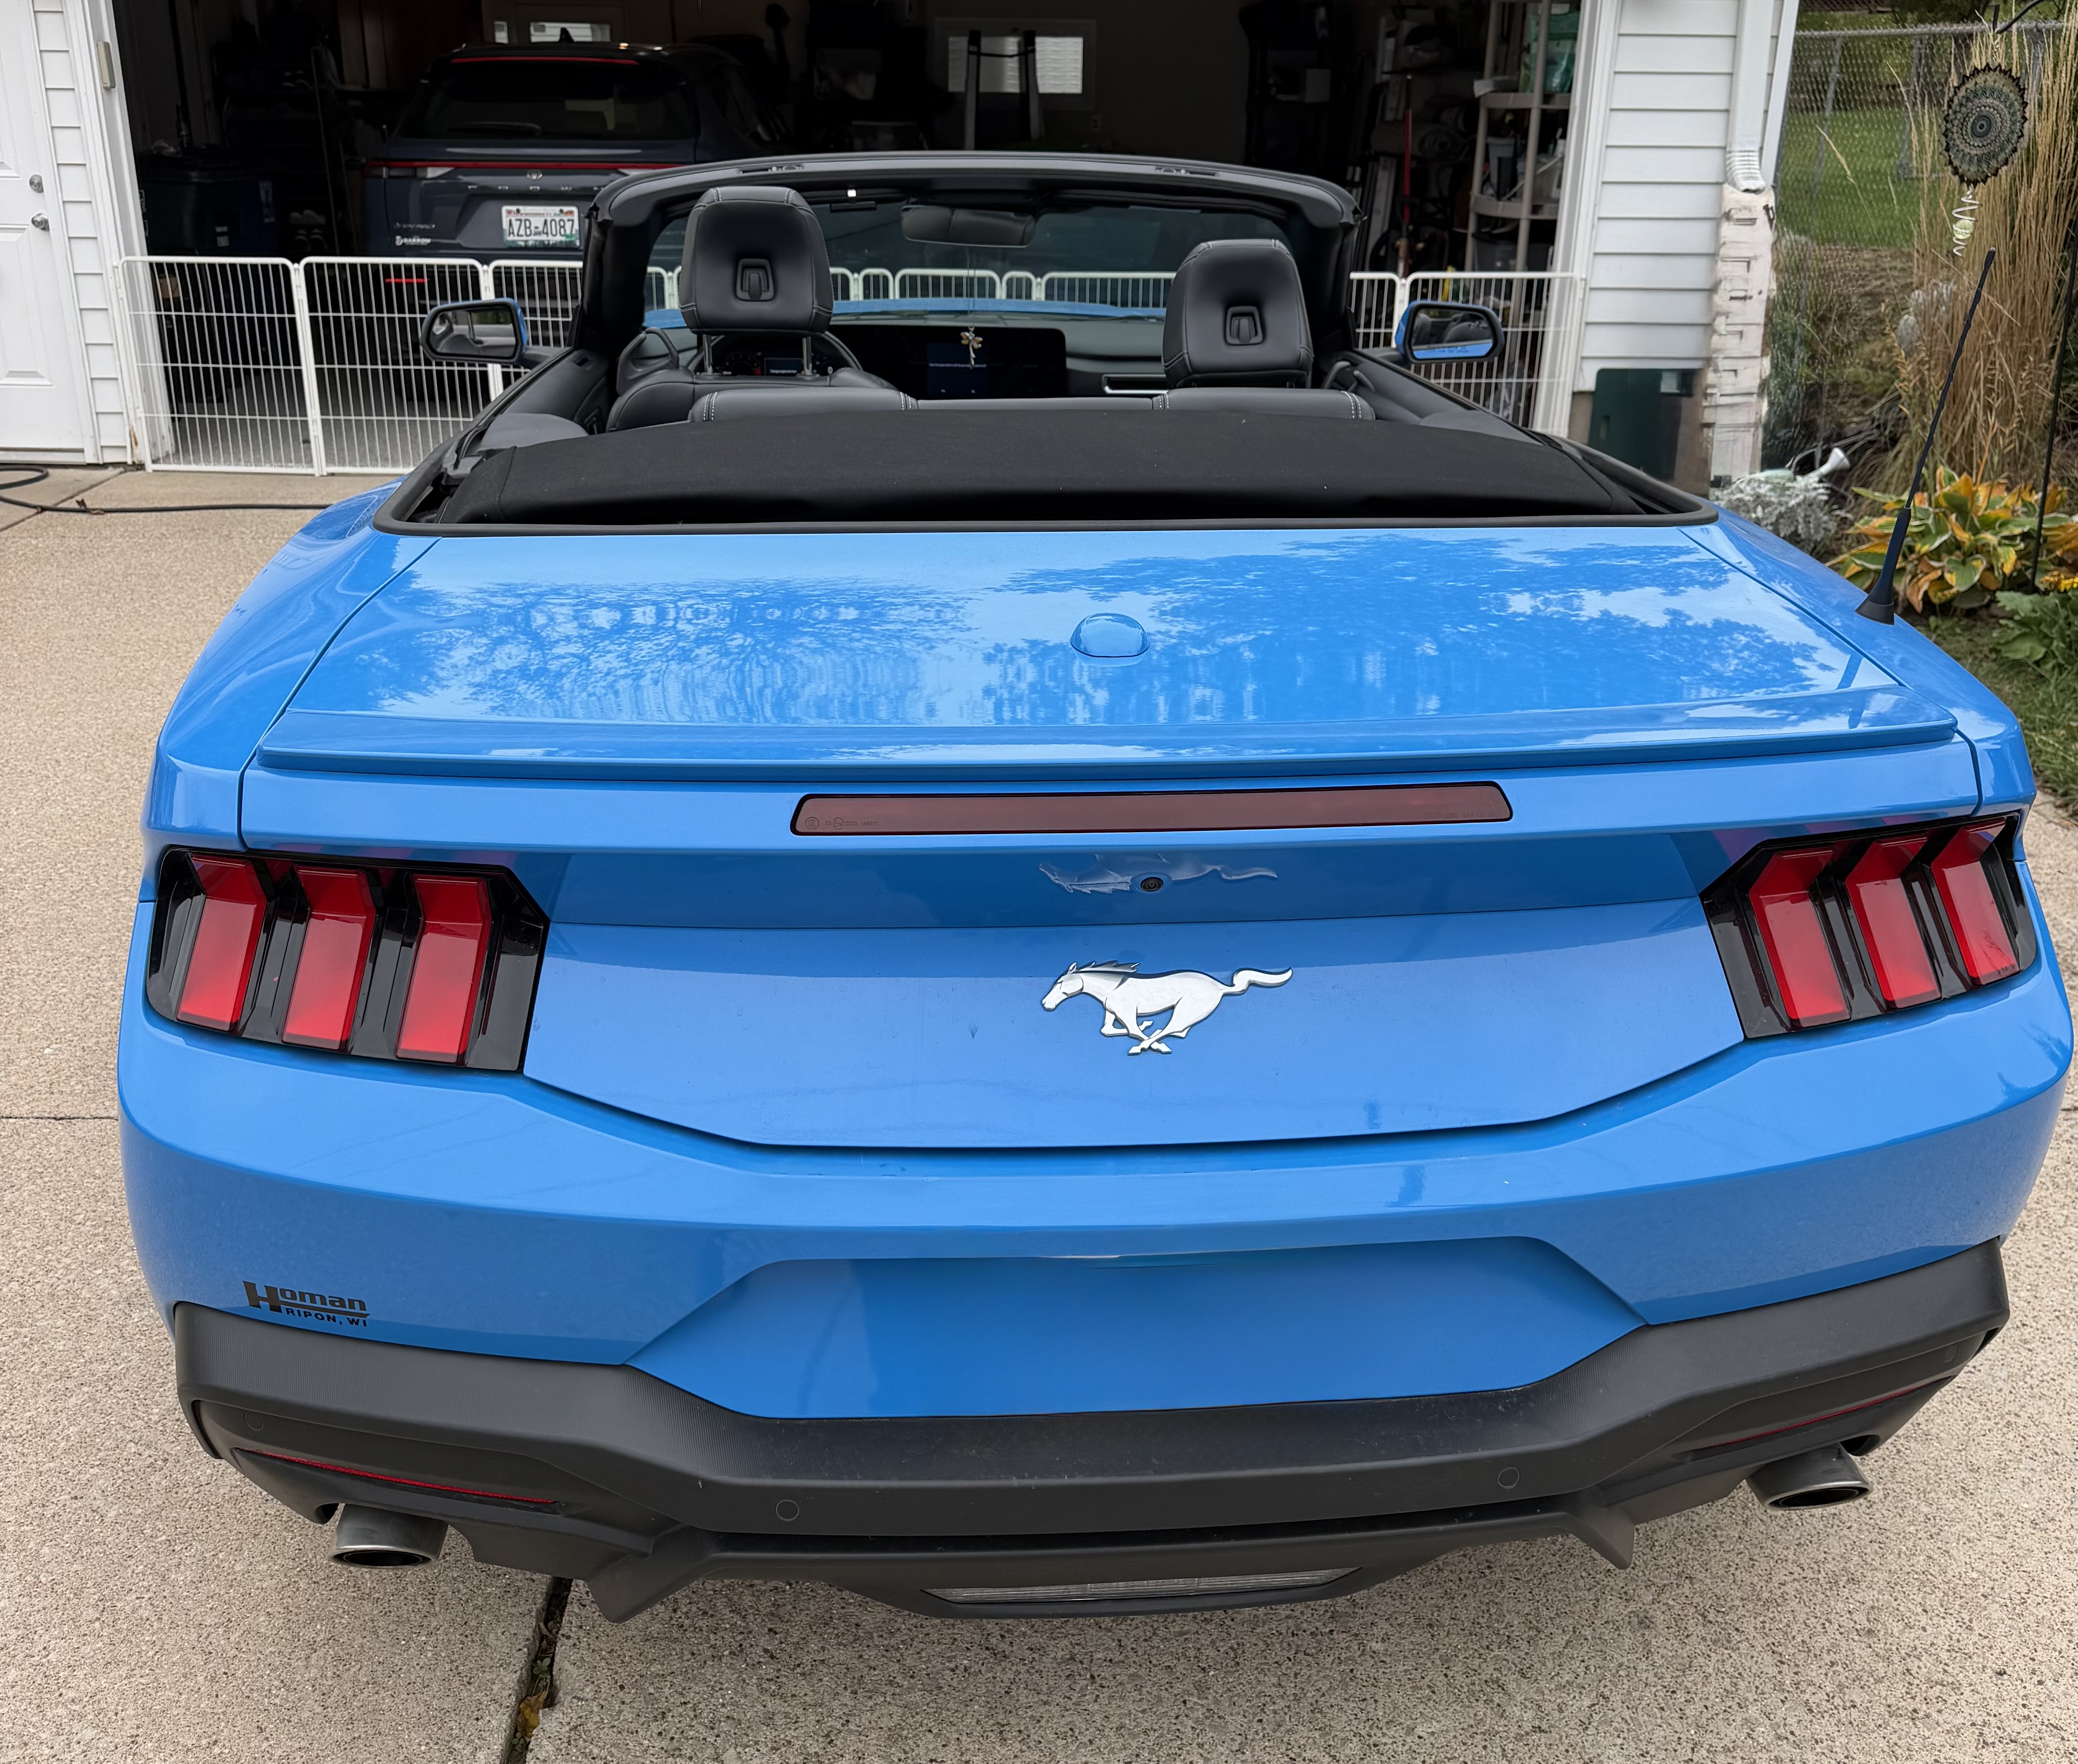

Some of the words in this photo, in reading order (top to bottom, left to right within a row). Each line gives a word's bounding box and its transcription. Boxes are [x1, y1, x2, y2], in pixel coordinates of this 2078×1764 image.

[508, 218, 575, 237] AZB-4087
[242, 1280, 368, 1313] Homan
[286, 1307, 343, 1325] RIPON,
[347, 1317, 368, 1327] WI
